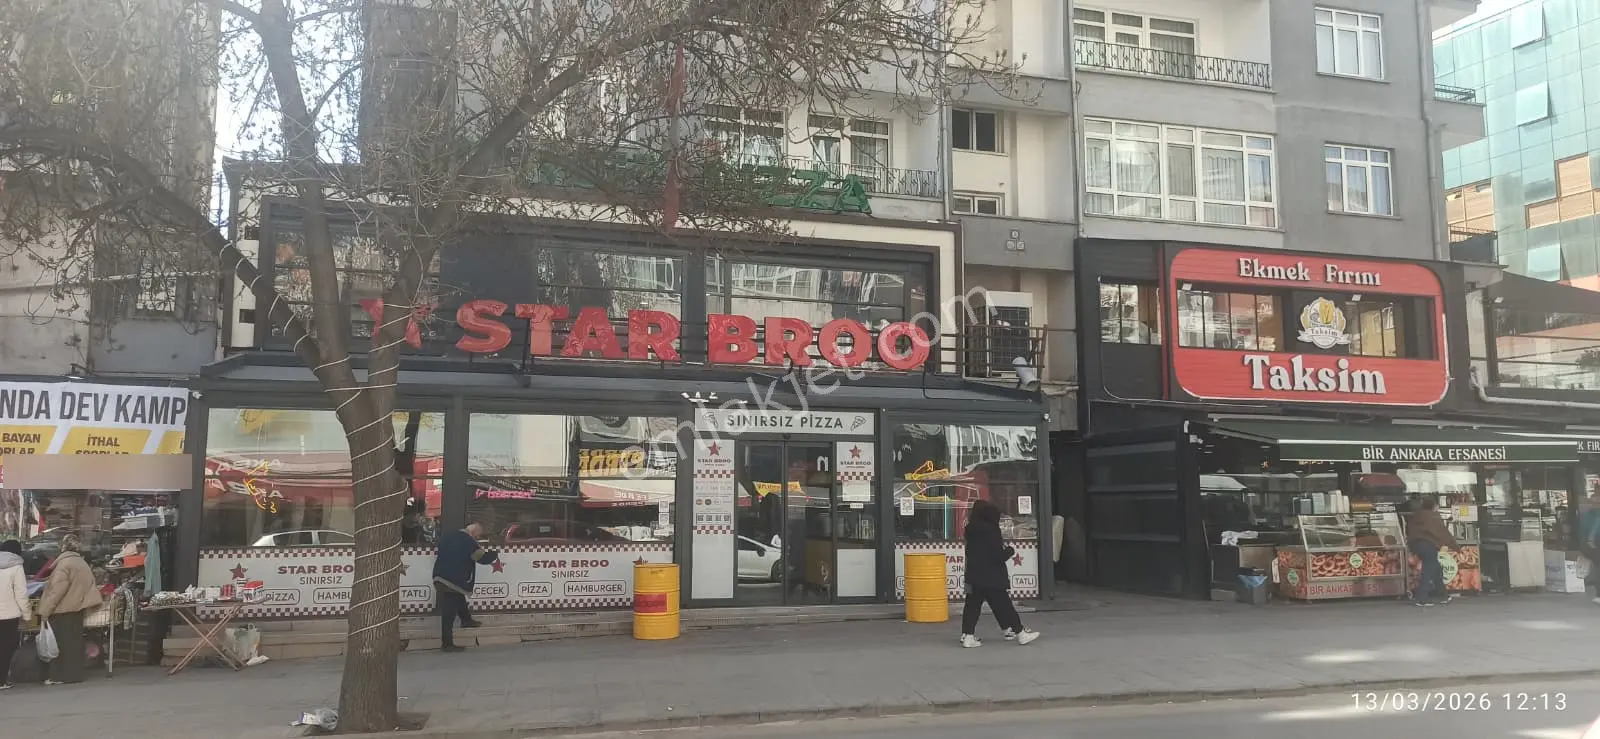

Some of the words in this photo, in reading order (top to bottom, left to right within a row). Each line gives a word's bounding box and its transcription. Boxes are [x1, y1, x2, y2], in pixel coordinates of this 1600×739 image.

[1238, 257, 1311, 282] Ekmek
[456, 299, 682, 361] STAR
[707, 313, 930, 370] BROO
[1244, 354, 1387, 394] Taksim
[60, 391, 109, 420] DEV
[114, 393, 187, 425] KAMP
[727, 413, 793, 428] SINIRSIZ
[800, 413, 843, 429] PİZZA
[2, 432, 41, 444] BAYAN
[87, 434, 120, 448] İTHAL
[1362, 444, 1384, 461] BİR
[1389, 447, 1443, 461] ANKARA
[1448, 446, 1506, 461] EFSANESİ
[277, 565, 318, 575] STAR
[322, 564, 354, 574] BRO
[532, 560, 567, 569] STAR
[571, 559, 609, 568] BROO
[551, 570, 589, 578] SINIRSIZ
[299, 575, 343, 585] SINIRSIZ
[1015, 577, 1034, 586] TATLI
[401, 589, 427, 598] TATLI
[474, 586, 505, 597] ÇECEK
[521, 584, 548, 594] PİZZA
[567, 583, 623, 593] HAMBURGER
[317, 591, 352, 601] HAMBU
